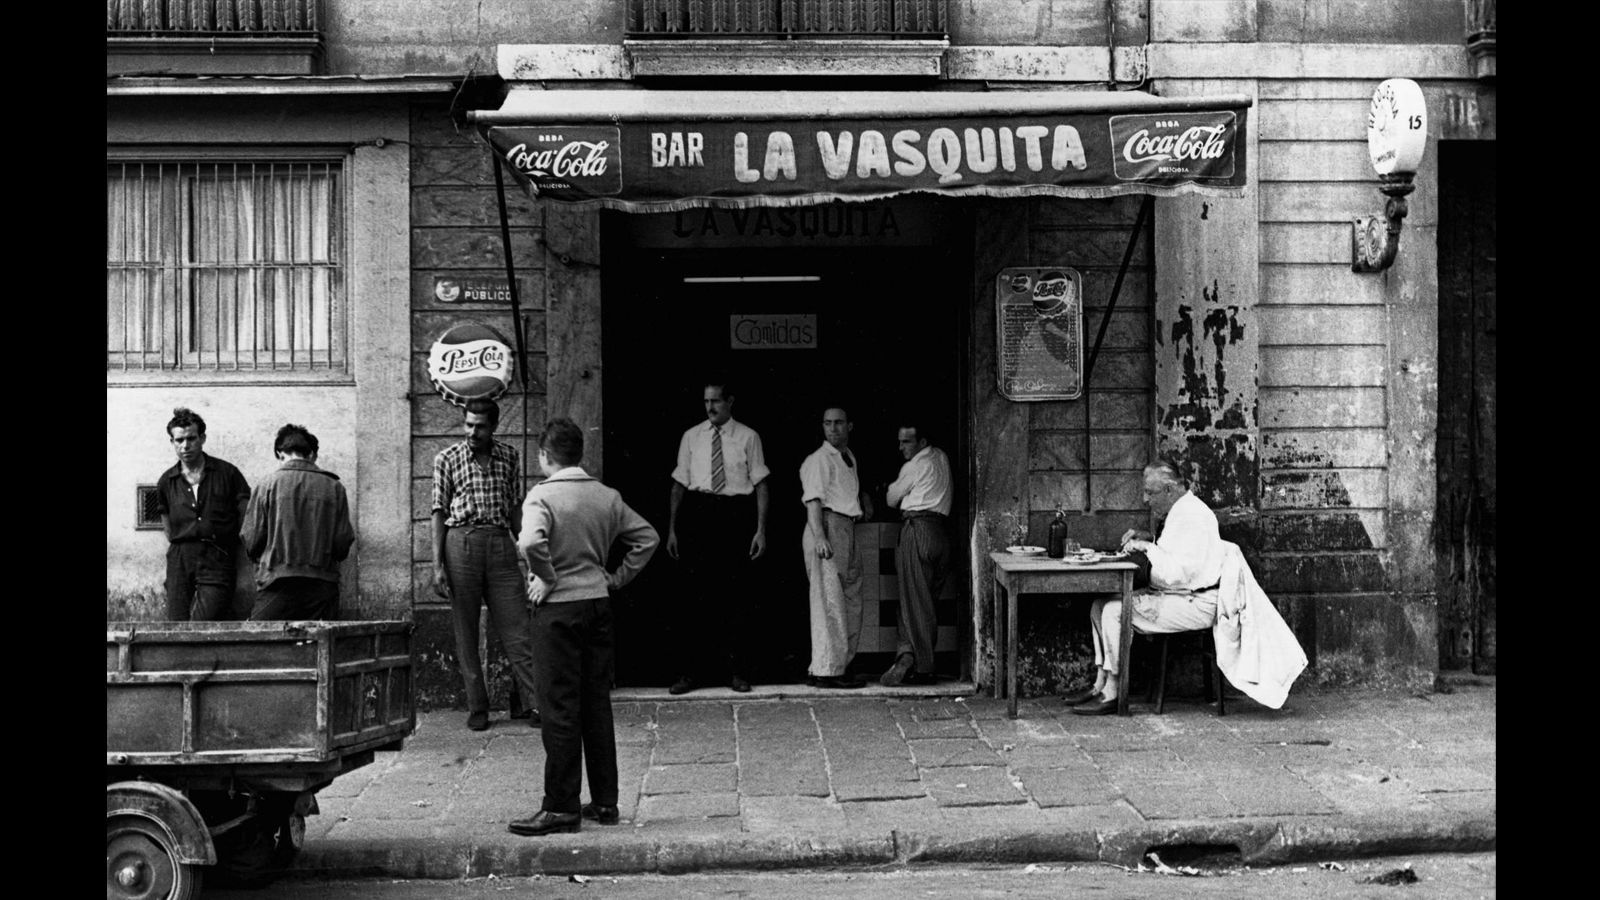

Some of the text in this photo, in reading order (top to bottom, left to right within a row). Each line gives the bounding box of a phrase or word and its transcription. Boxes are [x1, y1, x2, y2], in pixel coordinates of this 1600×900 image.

[1408, 114, 1422, 130] 15
[651, 125, 1087, 184] BAR LA VASQUITA
[1122, 124, 1227, 163] Coca-Cola
[673, 205, 900, 239] LA VASQUITA
[735, 319, 813, 345] Comidas
